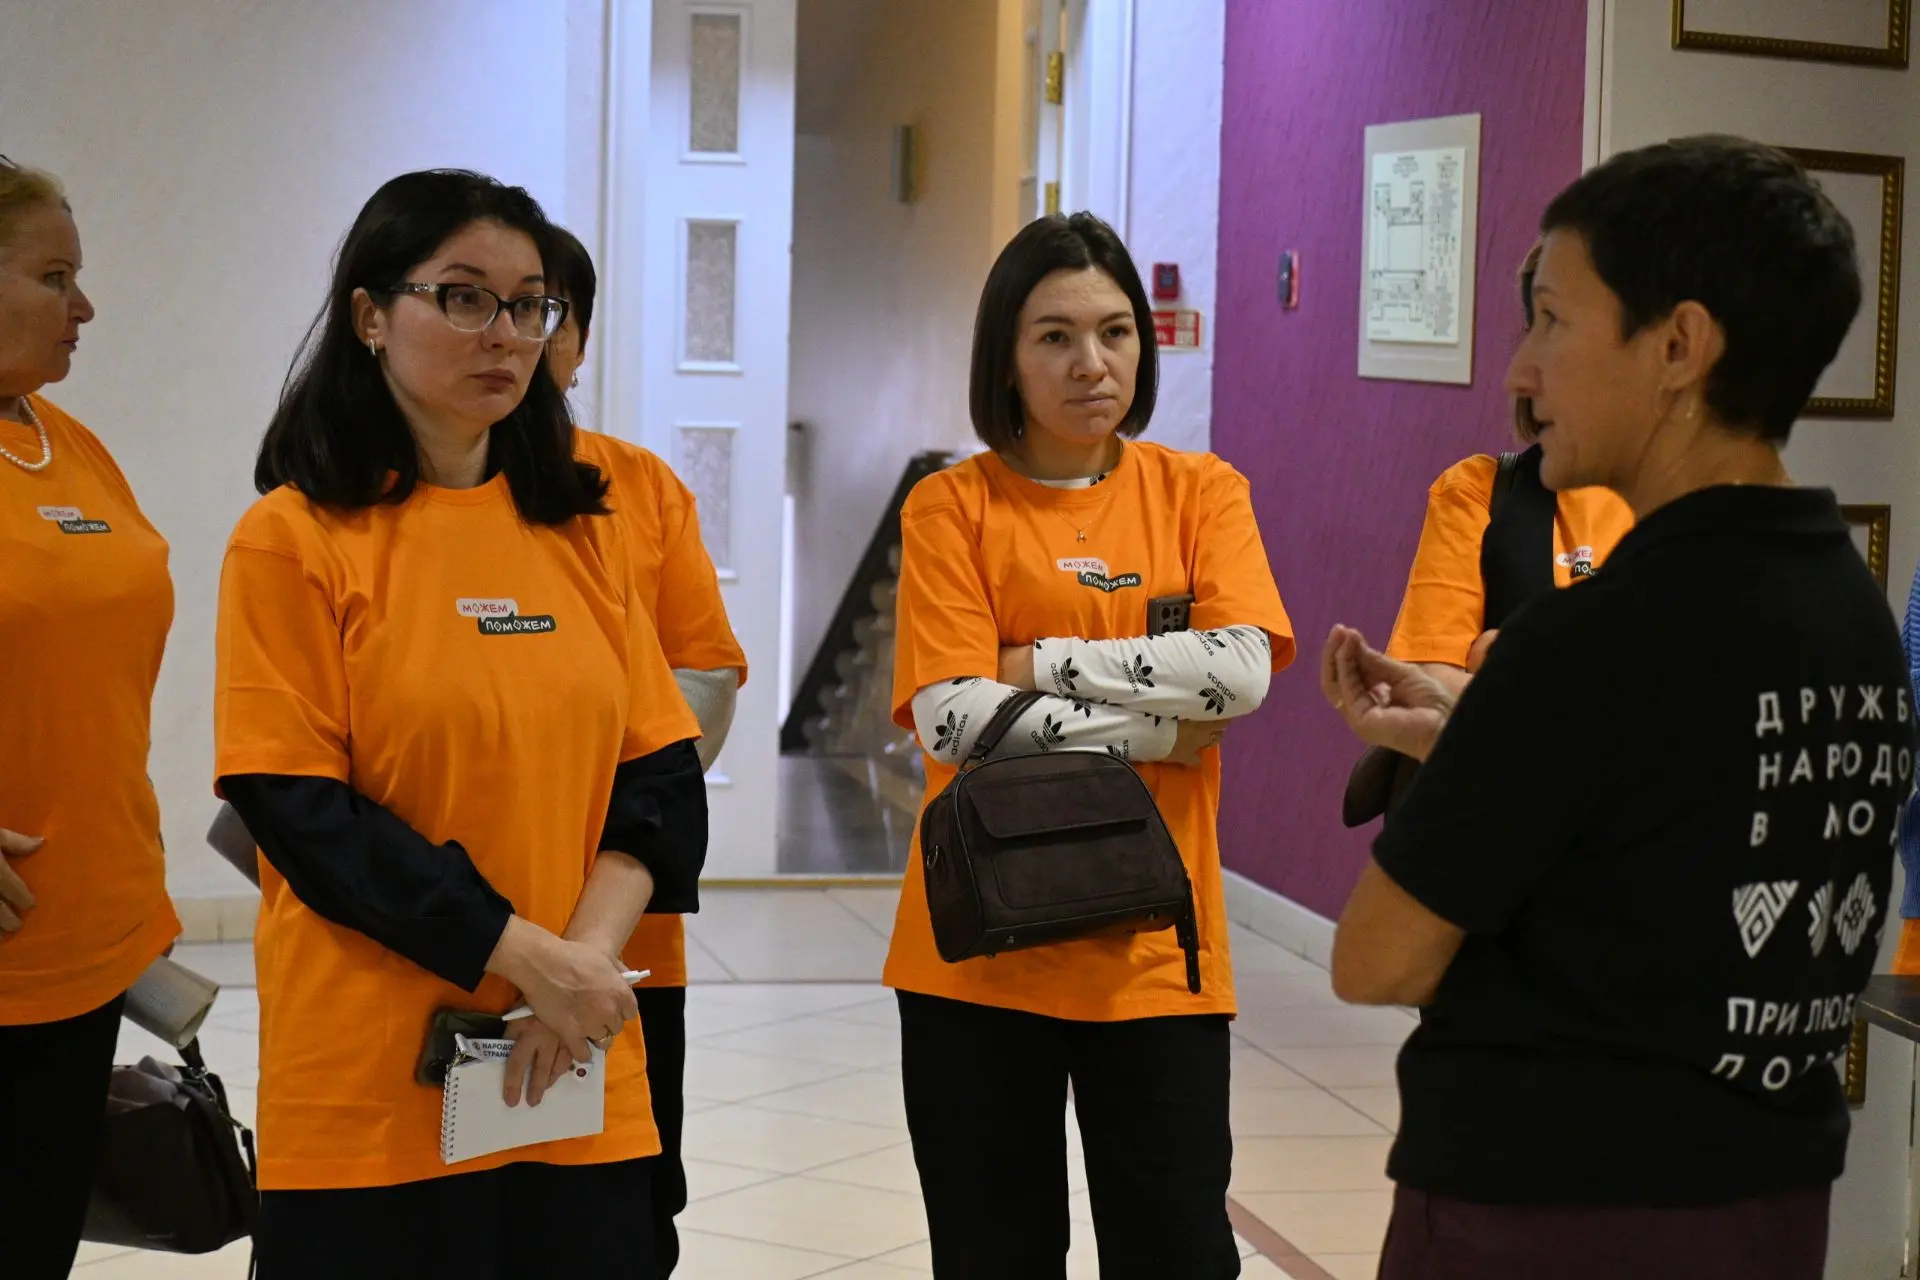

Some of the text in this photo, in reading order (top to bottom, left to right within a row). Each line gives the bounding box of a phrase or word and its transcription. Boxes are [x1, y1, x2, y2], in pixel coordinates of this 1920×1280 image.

[1085, 574, 1137, 591] ПОМОЖЕМ
[462, 603, 508, 613] МОЖЕМ
[485, 619, 551, 632] ПОМОЖЕМ
[1122, 660, 1140, 694] adidas
[1207, 671, 1236, 702] adidas
[951, 713, 969, 756] adidas
[1750, 811, 1769, 847] В
[1727, 996, 1800, 1036] ПРИ
